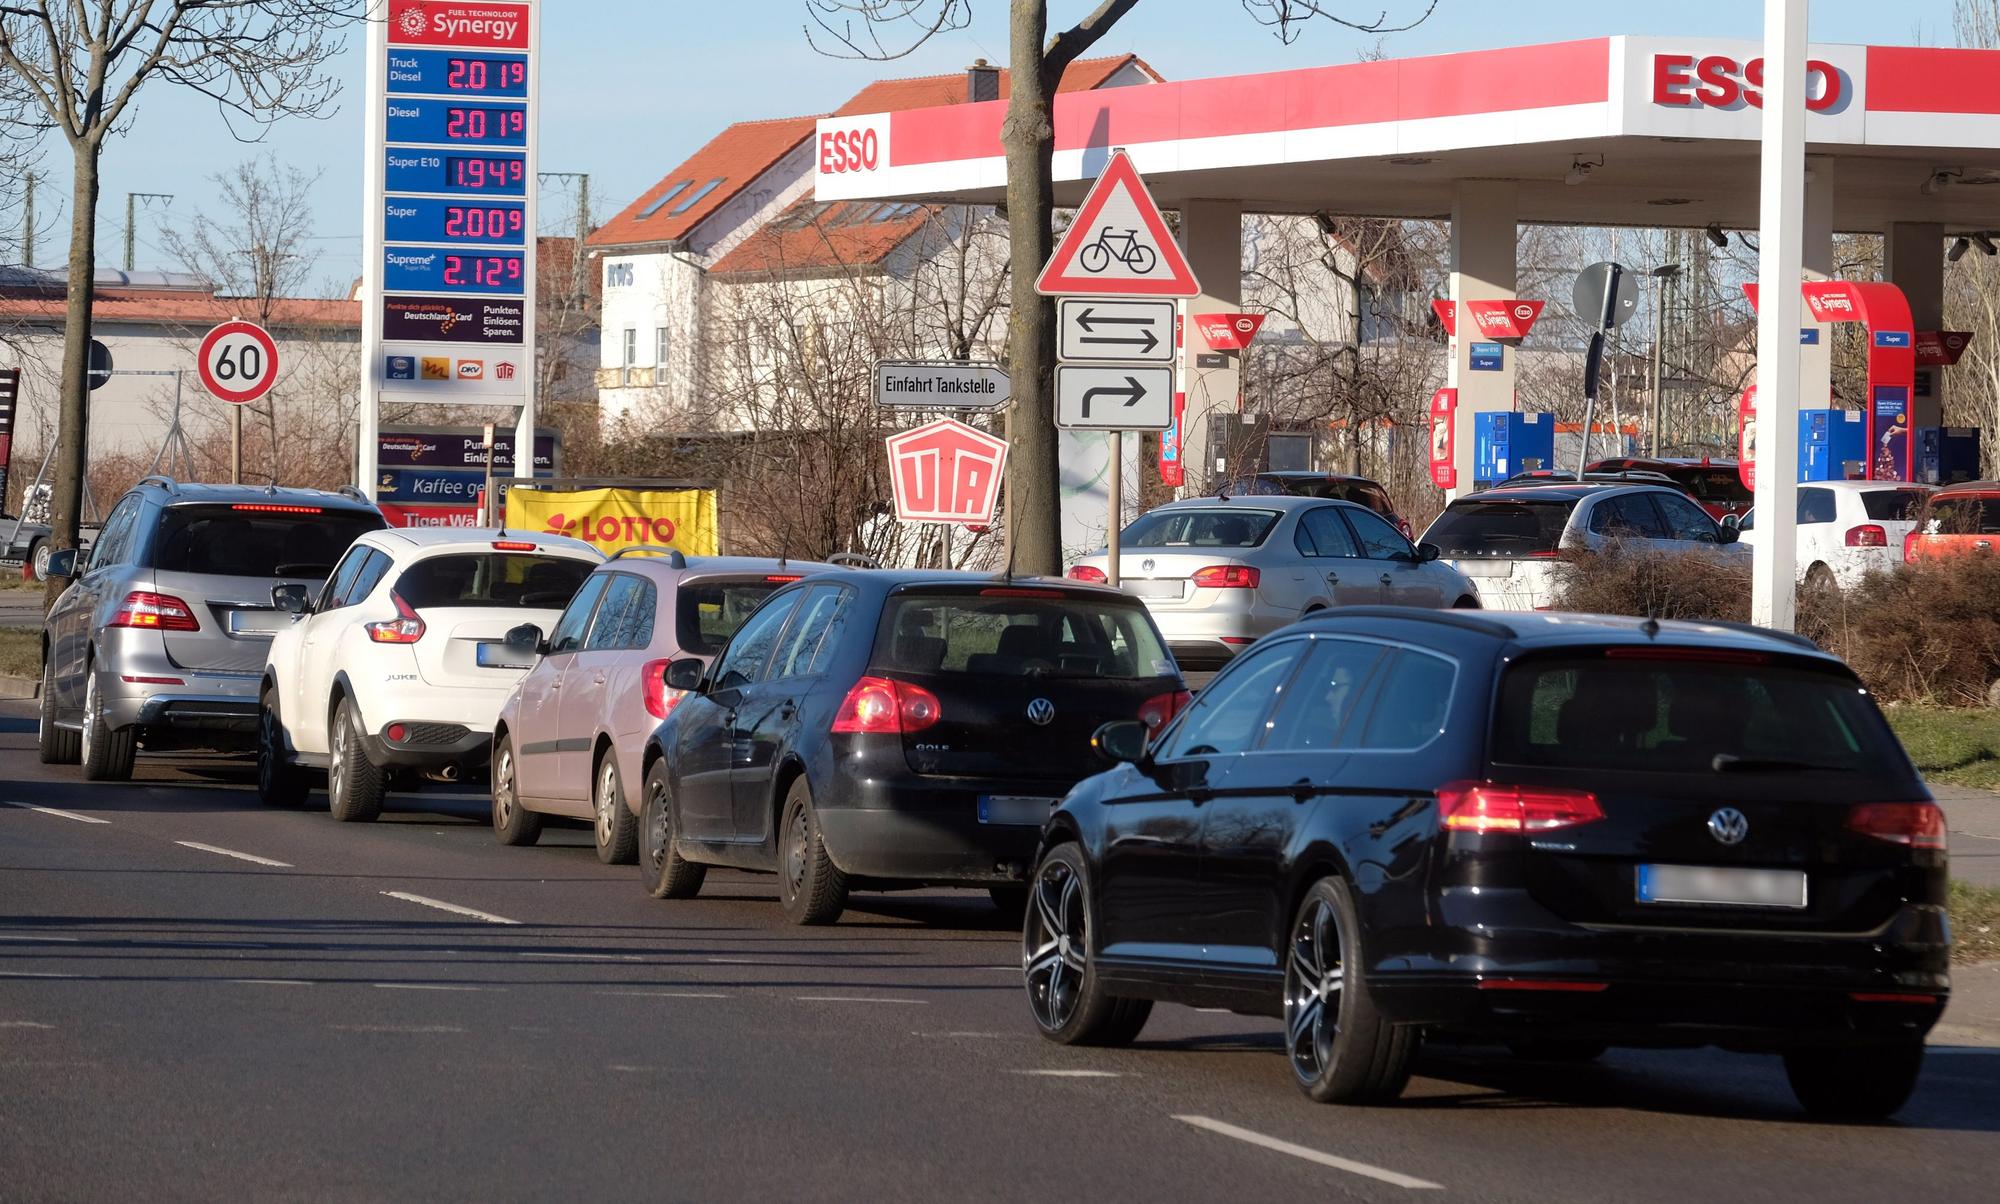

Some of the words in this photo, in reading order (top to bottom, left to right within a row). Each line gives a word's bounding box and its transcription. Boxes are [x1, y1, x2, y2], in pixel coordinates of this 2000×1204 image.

[448, 9, 467, 17] FUEL
[468, 10, 518, 18] TECHNOLOGY
[433, 13, 518, 40] Synergy
[390, 57, 418, 69] Truck
[390, 71, 421, 82] Diesel
[388, 106, 420, 118] Diesel
[820, 128, 879, 174] ESSO
[388, 156, 418, 169] Super
[420, 157, 440, 168] E10
[386, 206, 417, 219] Super
[446, 207, 522, 238] 2.009
[444, 256, 520, 286] 2.129
[483, 305, 521, 315] Punkten.
[1820, 296, 1853, 312] Synergy
[404, 311, 451, 321] Deutschland
[455, 313, 473, 321] Card
[483, 316, 521, 326] Einlösen.
[483, 326, 515, 337] Sparen.
[215, 344, 260, 381] 60
[885, 375, 933, 393] Einfahrt
[935, 376, 996, 394] Tankstelle
[464, 439, 510, 450] Punen.
[464, 452, 510, 463] Einlöen.
[413, 479, 462, 494] Kaffee
[403, 513, 449, 529] Tiger
[385, 674, 417, 682] JUKE
